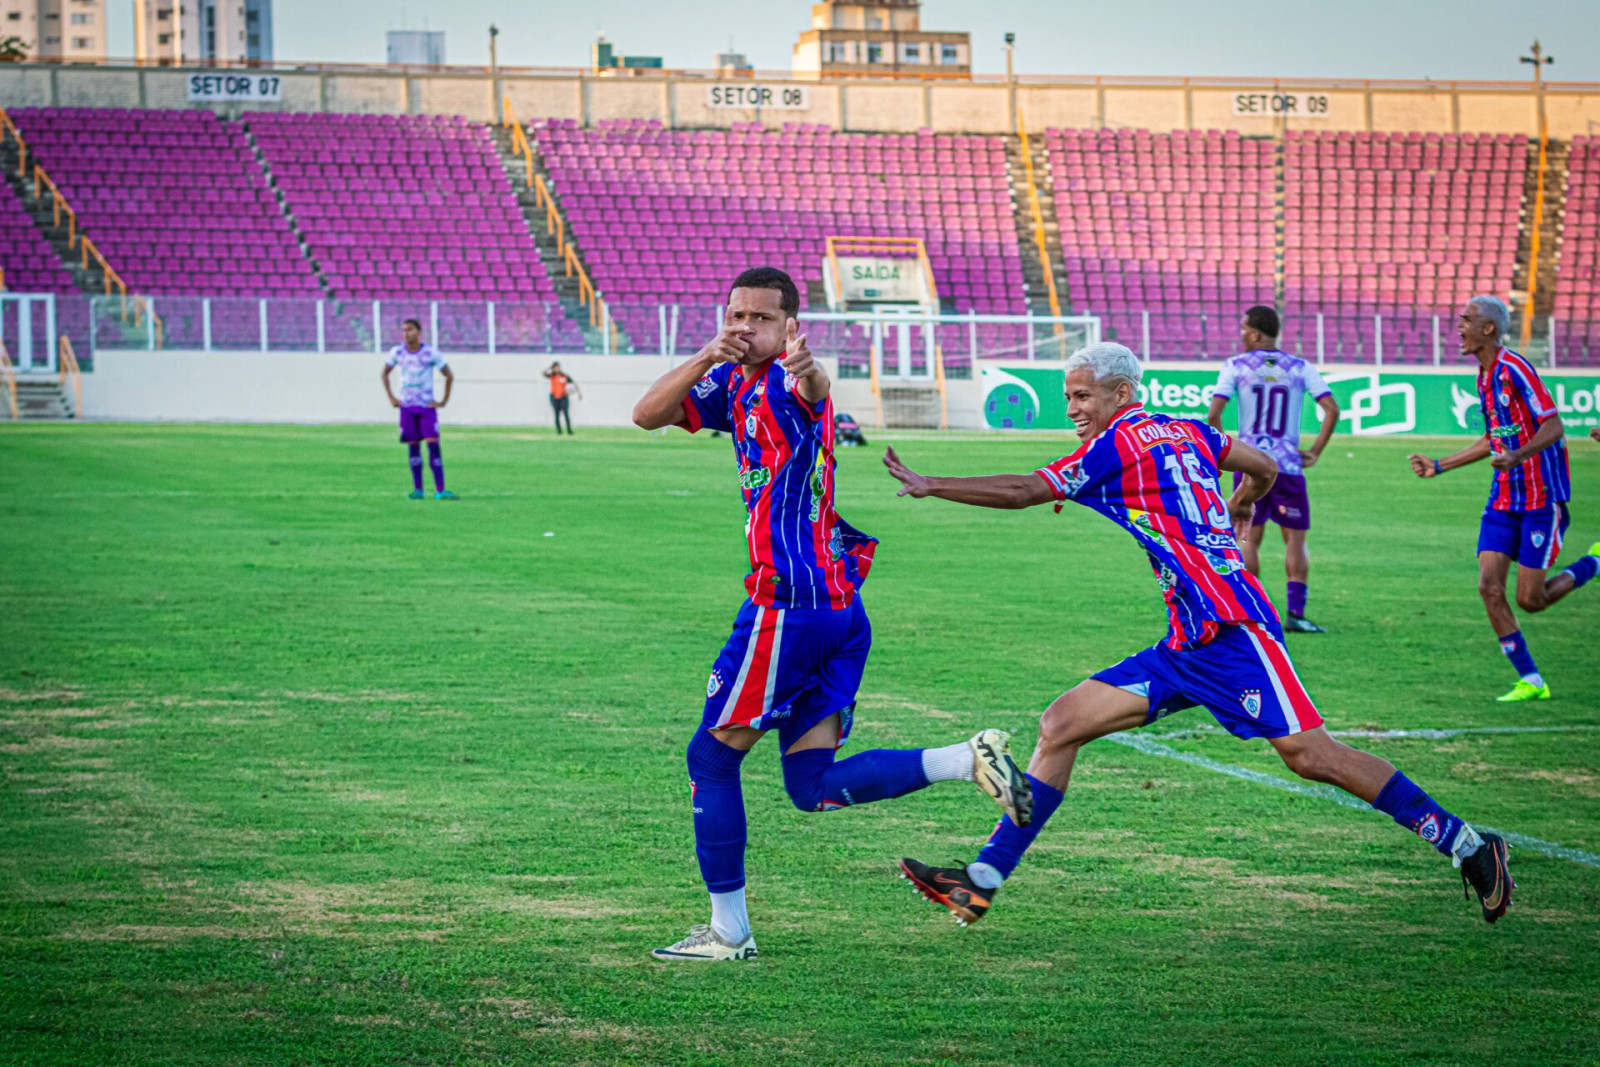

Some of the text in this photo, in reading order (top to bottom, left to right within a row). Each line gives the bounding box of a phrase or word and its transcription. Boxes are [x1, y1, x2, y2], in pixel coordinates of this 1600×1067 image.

[191, 76, 280, 95] SETOR 07
[711, 86, 802, 106] SETOR 08
[1236, 94, 1328, 113] SETOR 09
[1252, 384, 1289, 438] 10
[1164, 453, 1232, 529] 15
